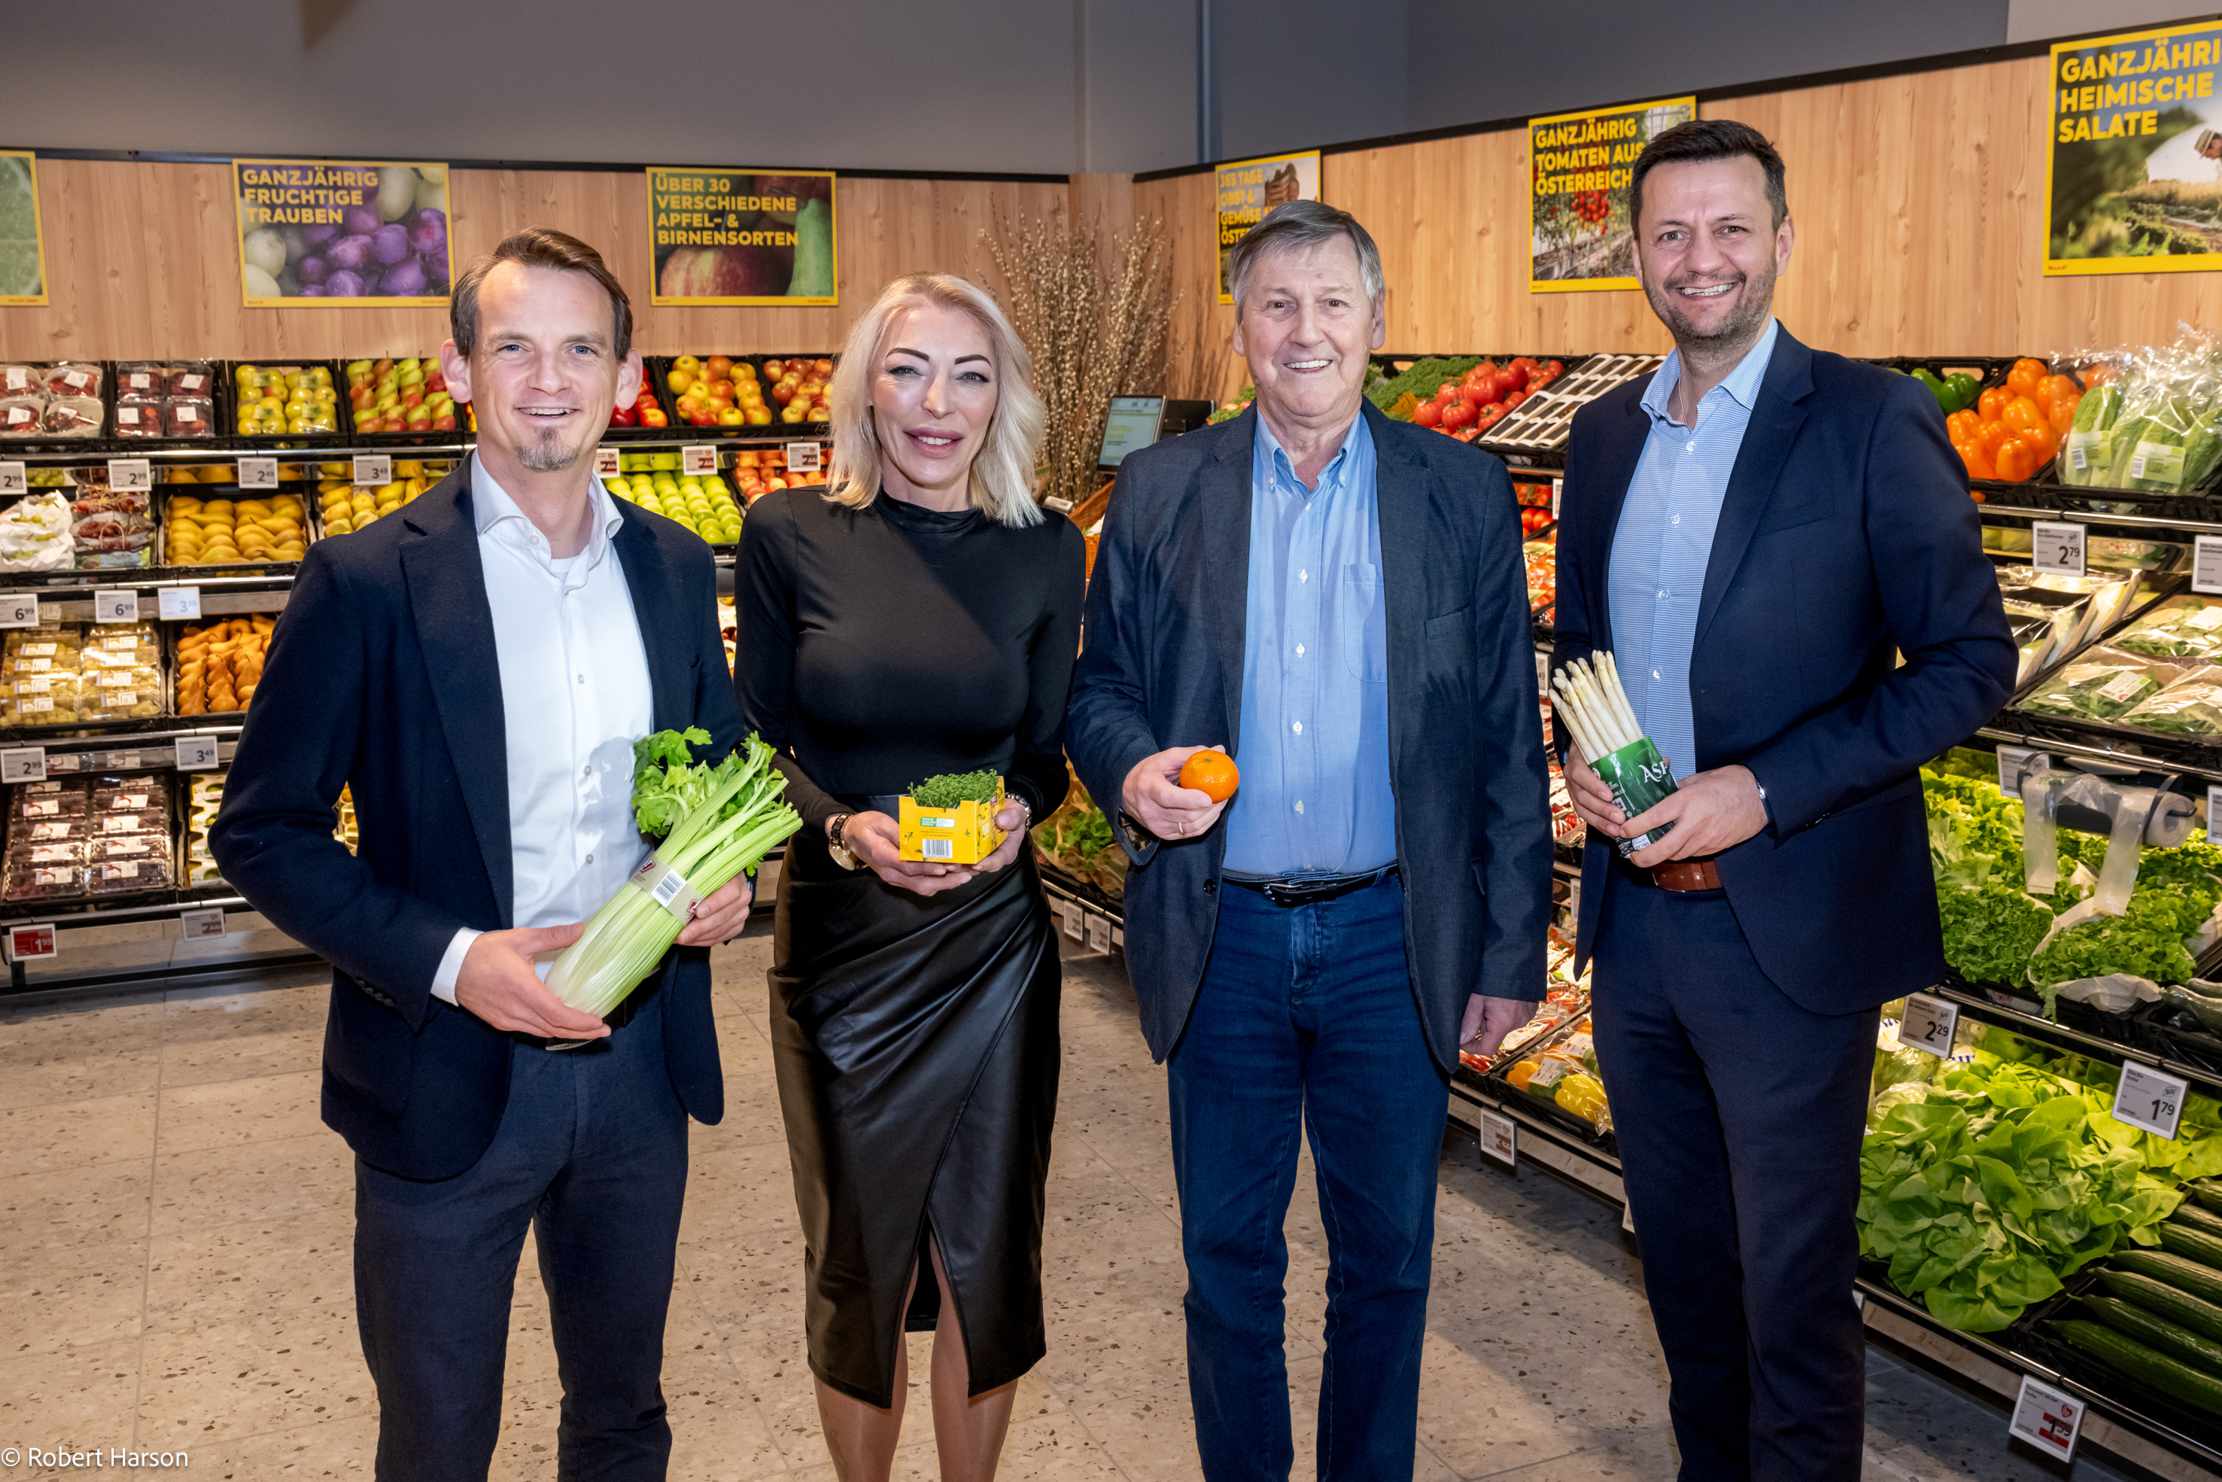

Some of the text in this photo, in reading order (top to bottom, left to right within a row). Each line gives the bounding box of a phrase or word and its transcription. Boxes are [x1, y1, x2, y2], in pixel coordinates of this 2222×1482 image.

[2061, 37, 2221, 83] GANZJÄHRI
[2060, 72, 2214, 113] HEIMISCHE
[1535, 118, 1637, 148] GANZJÄHRIG
[2058, 110, 2158, 143] SALATE
[1535, 145, 1610, 171] TOMATEN
[243, 167, 378, 187] GANZJÄHRIG
[655, 173, 730, 193] ÜBER 30
[1535, 168, 1633, 196] ÖSTERREICH
[244, 188, 363, 205] FRUCHTIGE
[656, 194, 797, 212] VERSCHIEDENE
[246, 207, 343, 224] TRAUBEN
[727, 213, 739, 228] &
[657, 230, 799, 246] BIRNENSORTEN
